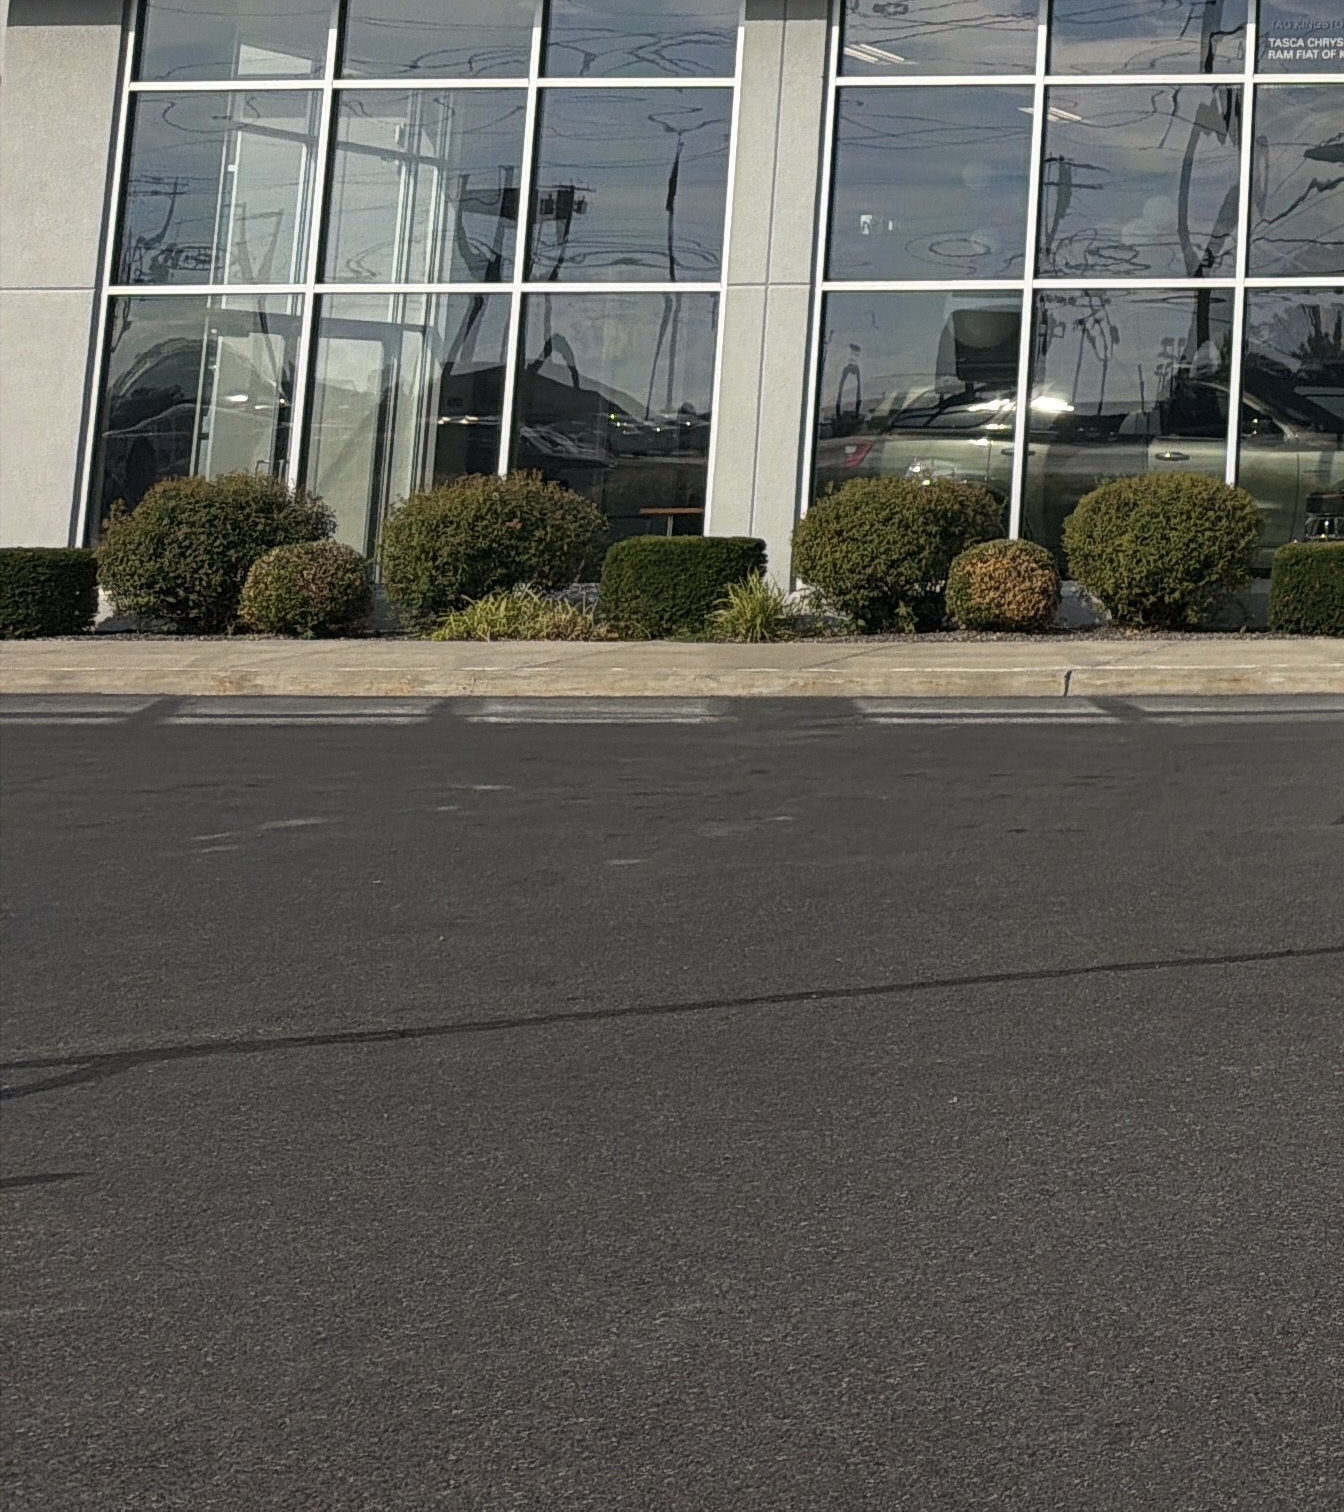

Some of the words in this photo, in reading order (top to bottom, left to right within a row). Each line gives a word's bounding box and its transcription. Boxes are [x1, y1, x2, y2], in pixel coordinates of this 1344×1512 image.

[1268, 38, 1304, 48] TASCA
[1268, 49, 1294, 59] RAM
[1296, 49, 1320, 59] FIAT
[1322, 49, 1336, 59] OF
